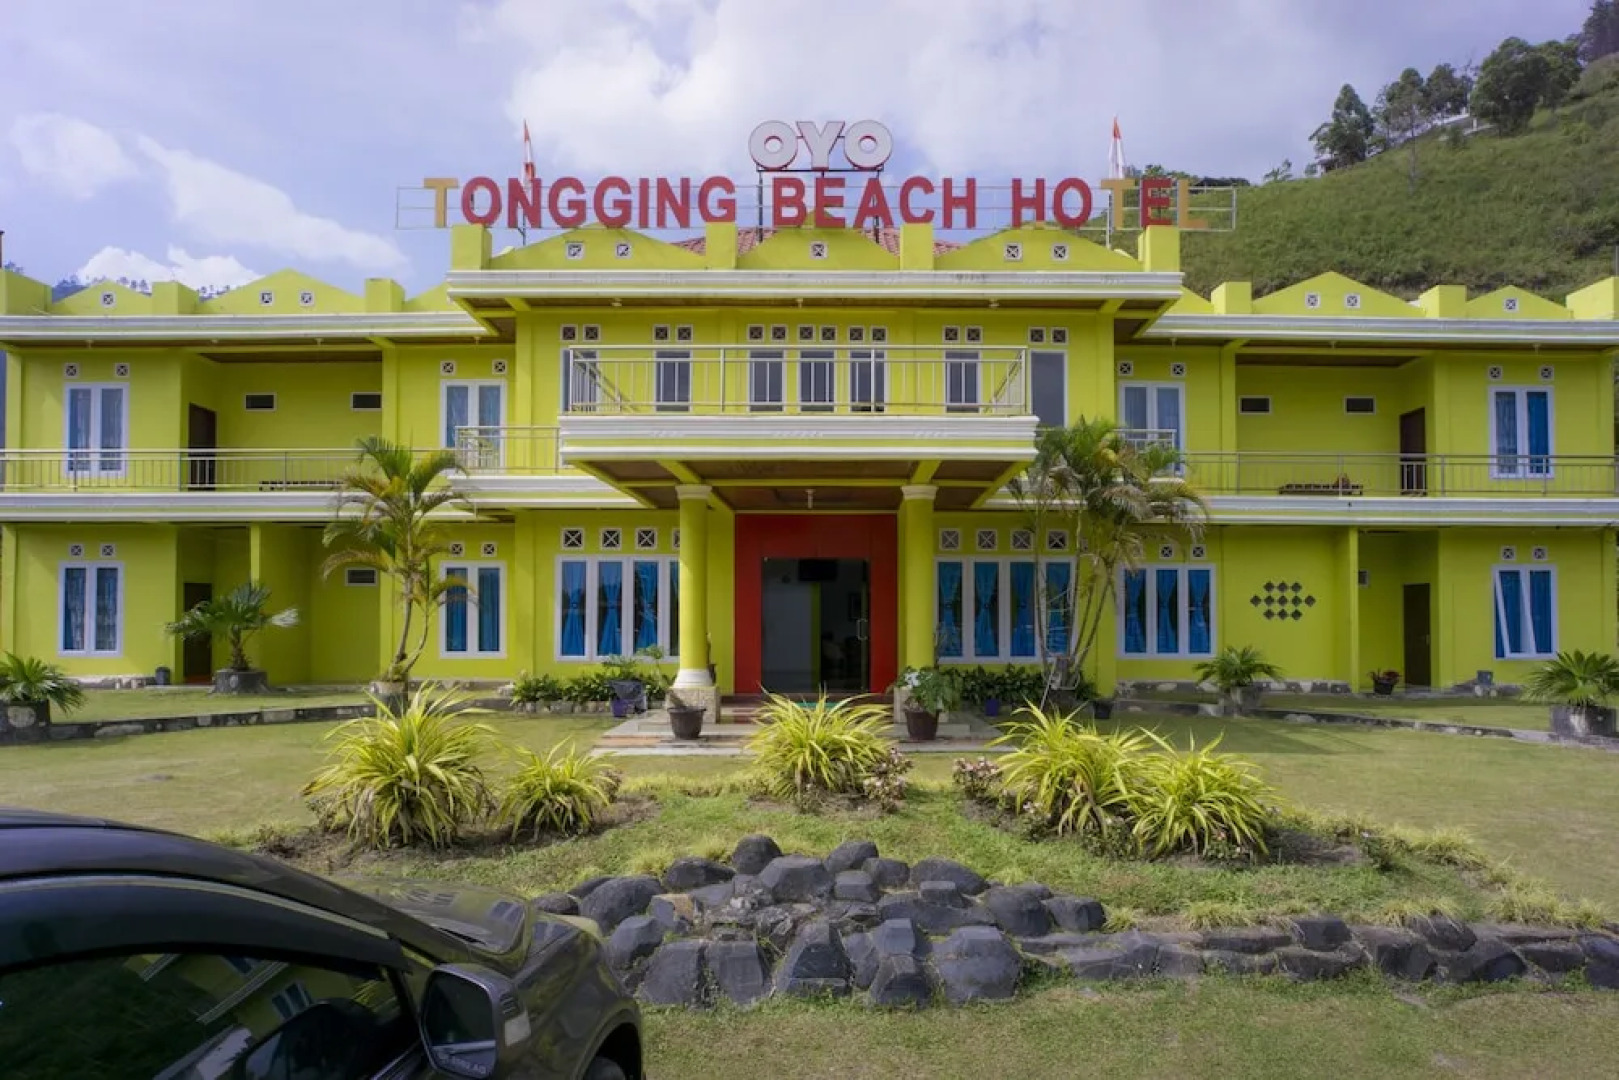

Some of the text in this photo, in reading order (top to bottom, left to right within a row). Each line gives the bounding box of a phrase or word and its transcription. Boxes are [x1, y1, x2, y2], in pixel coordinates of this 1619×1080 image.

[748, 120, 893, 171] OYO
[424, 176, 1208, 230] TONGGING BEACH HOTEL
